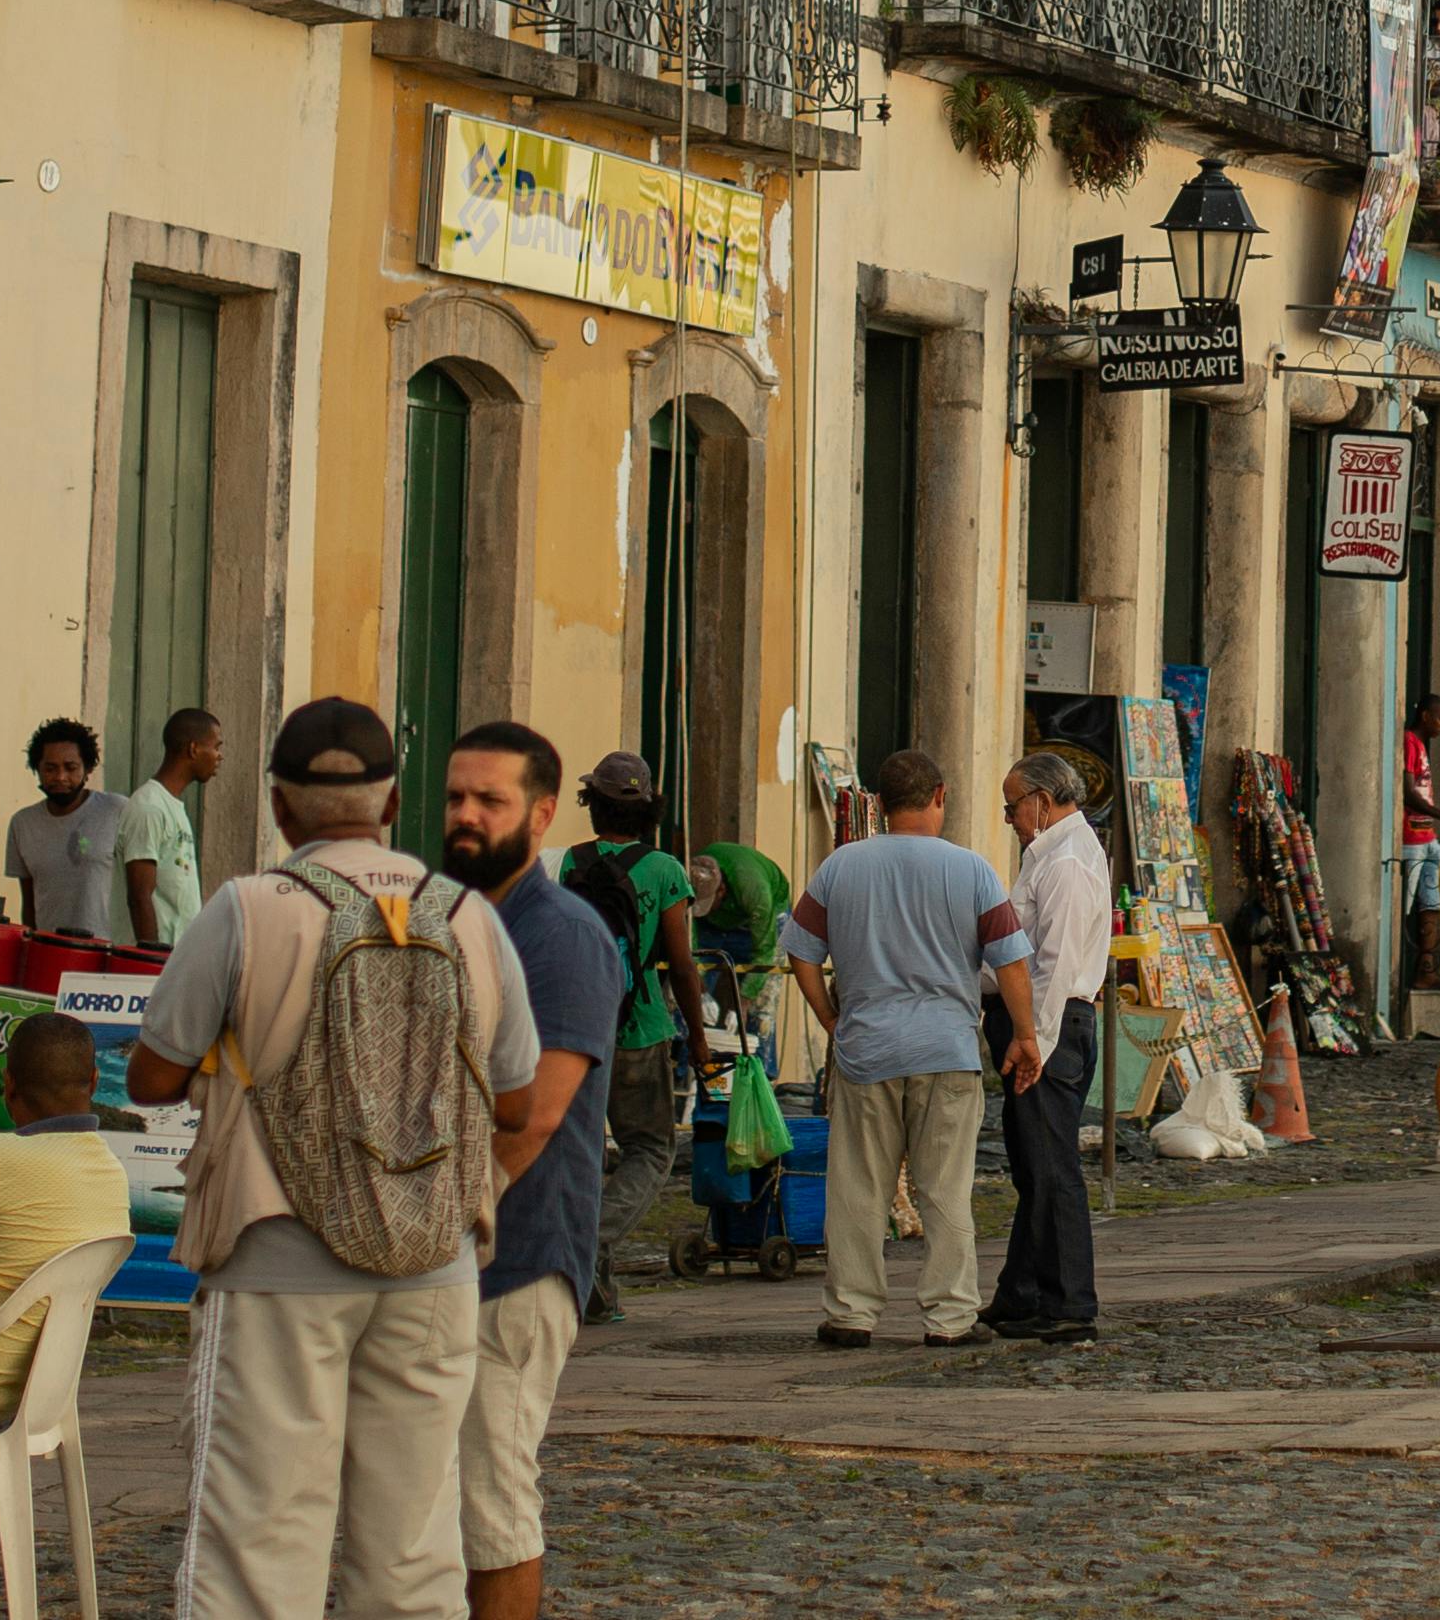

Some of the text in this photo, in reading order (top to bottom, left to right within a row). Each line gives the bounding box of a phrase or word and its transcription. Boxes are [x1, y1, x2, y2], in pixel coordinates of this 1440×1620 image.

[510, 168, 608, 268] BANCO
[613, 209, 650, 276] DO
[1101, 355, 1239, 383] GALERIA DE ARTE
[1330, 518, 1402, 542] COLISEU
[1323, 541, 1400, 570] RESTAURANTE
[366, 872, 419, 888] TURIS
[61, 992, 124, 1013] MORRO
[134, 1145, 169, 1155] FRADES
[171, 1147, 177, 1156] E
